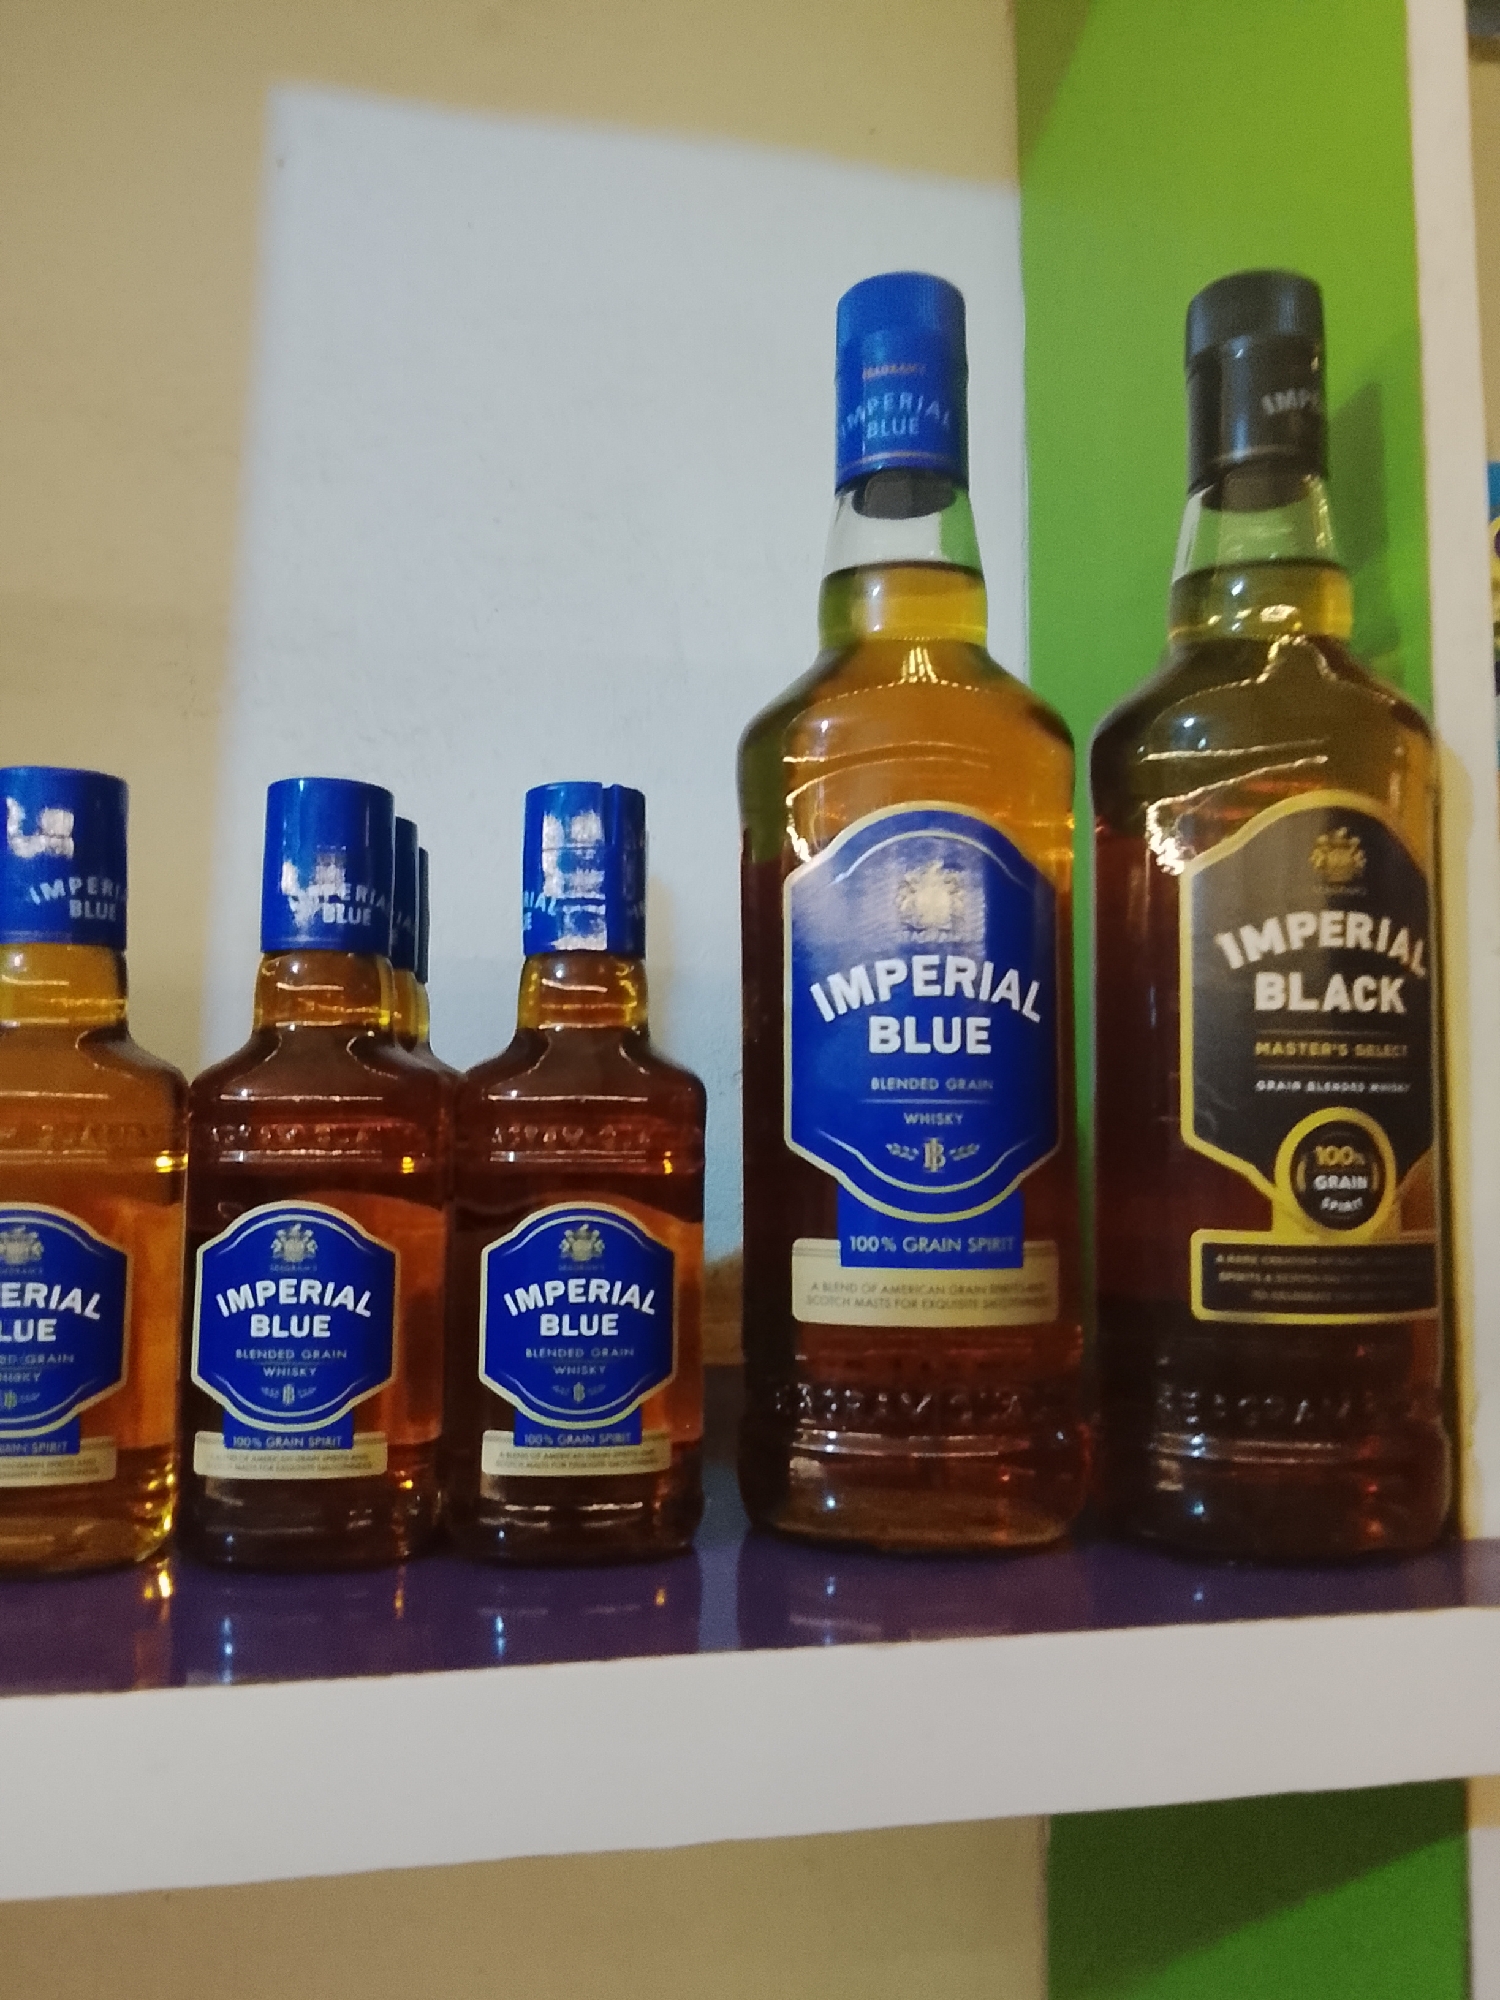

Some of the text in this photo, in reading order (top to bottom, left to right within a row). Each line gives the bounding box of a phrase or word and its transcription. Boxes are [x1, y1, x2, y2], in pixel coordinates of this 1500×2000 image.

[866, 416, 920, 438] BLUE
[69, 899, 116, 921] BLUE
[322, 902, 372, 926] BLUE
[1213, 909, 1427, 978] IMPERIAL
[809, 954, 1042, 1023] IMPERIAL
[1253, 971, 1407, 1014] BLACK
[868, 1016, 992, 1055] BLUE
[870, 1077, 994, 1091] BLENDED GRAIN
[903, 1112, 963, 1125] WHISKY
[1313, 1174, 1369, 1191] GRAIN
[849, 1235, 1016, 1252] 100% GRAIN SPIRIT
[216, 1278, 372, 1318] IMPERIAL
[504, 1278, 656, 1317] IMPERIAL
[250, 1314, 331, 1338] BLUE
[540, 1313, 619, 1337] BLUE
[235, 1348, 348, 1360] BLENDED GRAIN
[525, 1347, 635, 1359] BLENDED GRAIN
[263, 1365, 317, 1378] WHISKY
[553, 1364, 606, 1376] WHISKY
[266, 1436, 304, 1449] GRAIN
